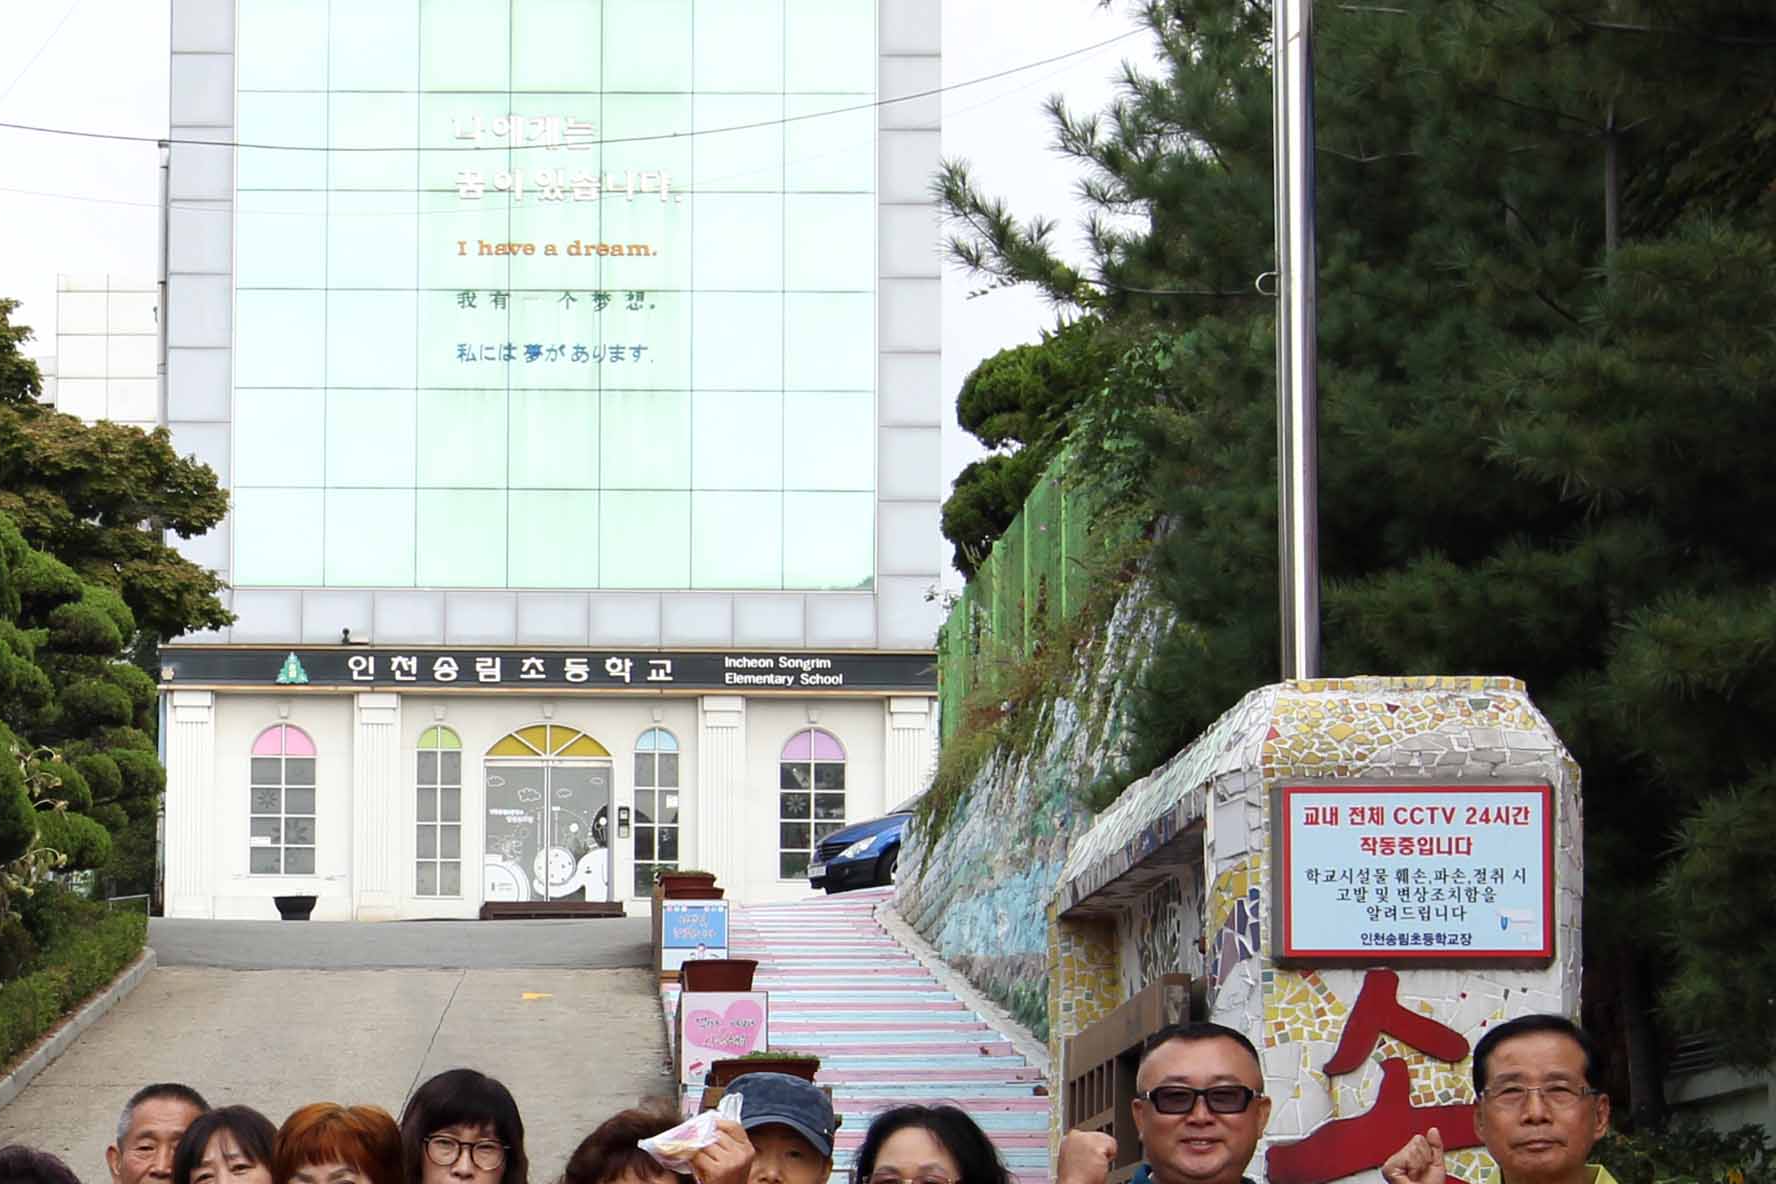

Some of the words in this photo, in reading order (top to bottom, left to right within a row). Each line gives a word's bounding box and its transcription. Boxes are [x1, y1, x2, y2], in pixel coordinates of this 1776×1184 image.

[457, 240, 467, 256] I
[477, 239, 536, 257] have
[544, 243, 559, 257] a
[566, 239, 658, 257] dream.
[347, 655, 673, 683] 인천송림초등학교
[724, 656, 774, 669] Incheon
[778, 656, 831, 671] Songrim
[724, 672, 794, 686] Elementary
[800, 672, 843, 686] School
[1303, 806, 1339, 826] 교내
[1348, 806, 1385, 826] 전체
[1392, 807, 1456, 825] CCTV
[1465, 806, 1530, 826] 24시간
[1360, 836, 1473, 856] 작동중입니다
[1306, 867, 1389, 885] 학교시설물
[1512, 867, 1527, 884] 시
[1336, 886, 1369, 903] 고발
[1375, 886, 1389, 903] 및
[1397, 886, 1497, 903] 변상조치함을
[1366, 904, 1467, 922] 알려드립니다
[1360, 932, 1473, 946] 인천송림초등학교장
